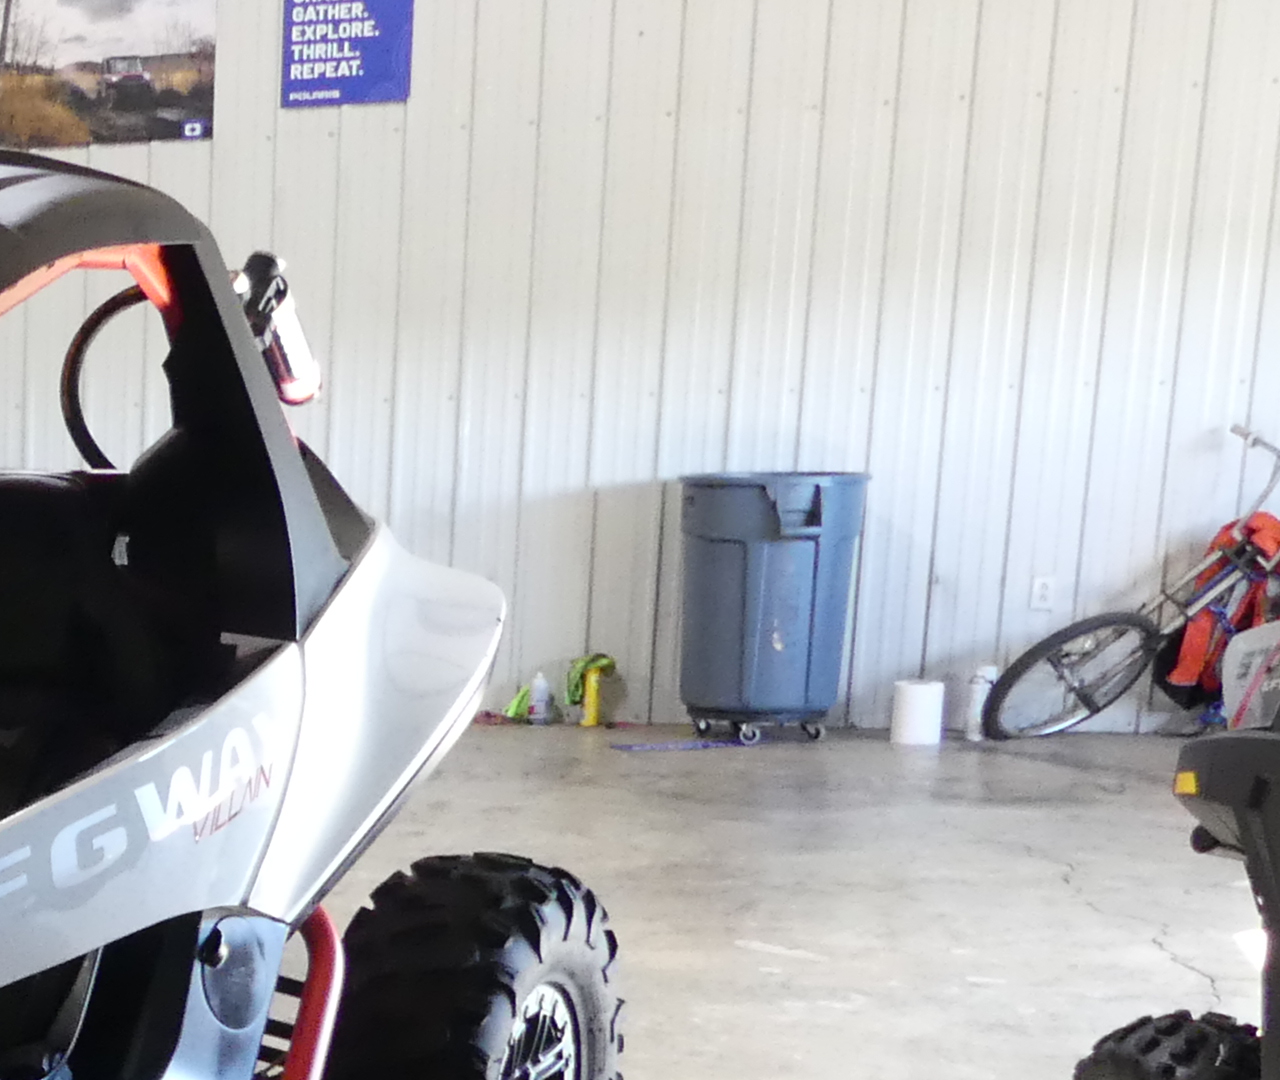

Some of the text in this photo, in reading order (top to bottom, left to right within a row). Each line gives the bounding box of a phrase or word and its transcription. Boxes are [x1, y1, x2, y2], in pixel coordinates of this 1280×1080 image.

[292, 2, 369, 22] GATHER.
[291, 19, 380, 42] EXPLORE.
[291, 41, 360, 61] THRILL.
[290, 60, 364, 80] REPEAT.
[192, 762, 274, 845] VILLAIN
